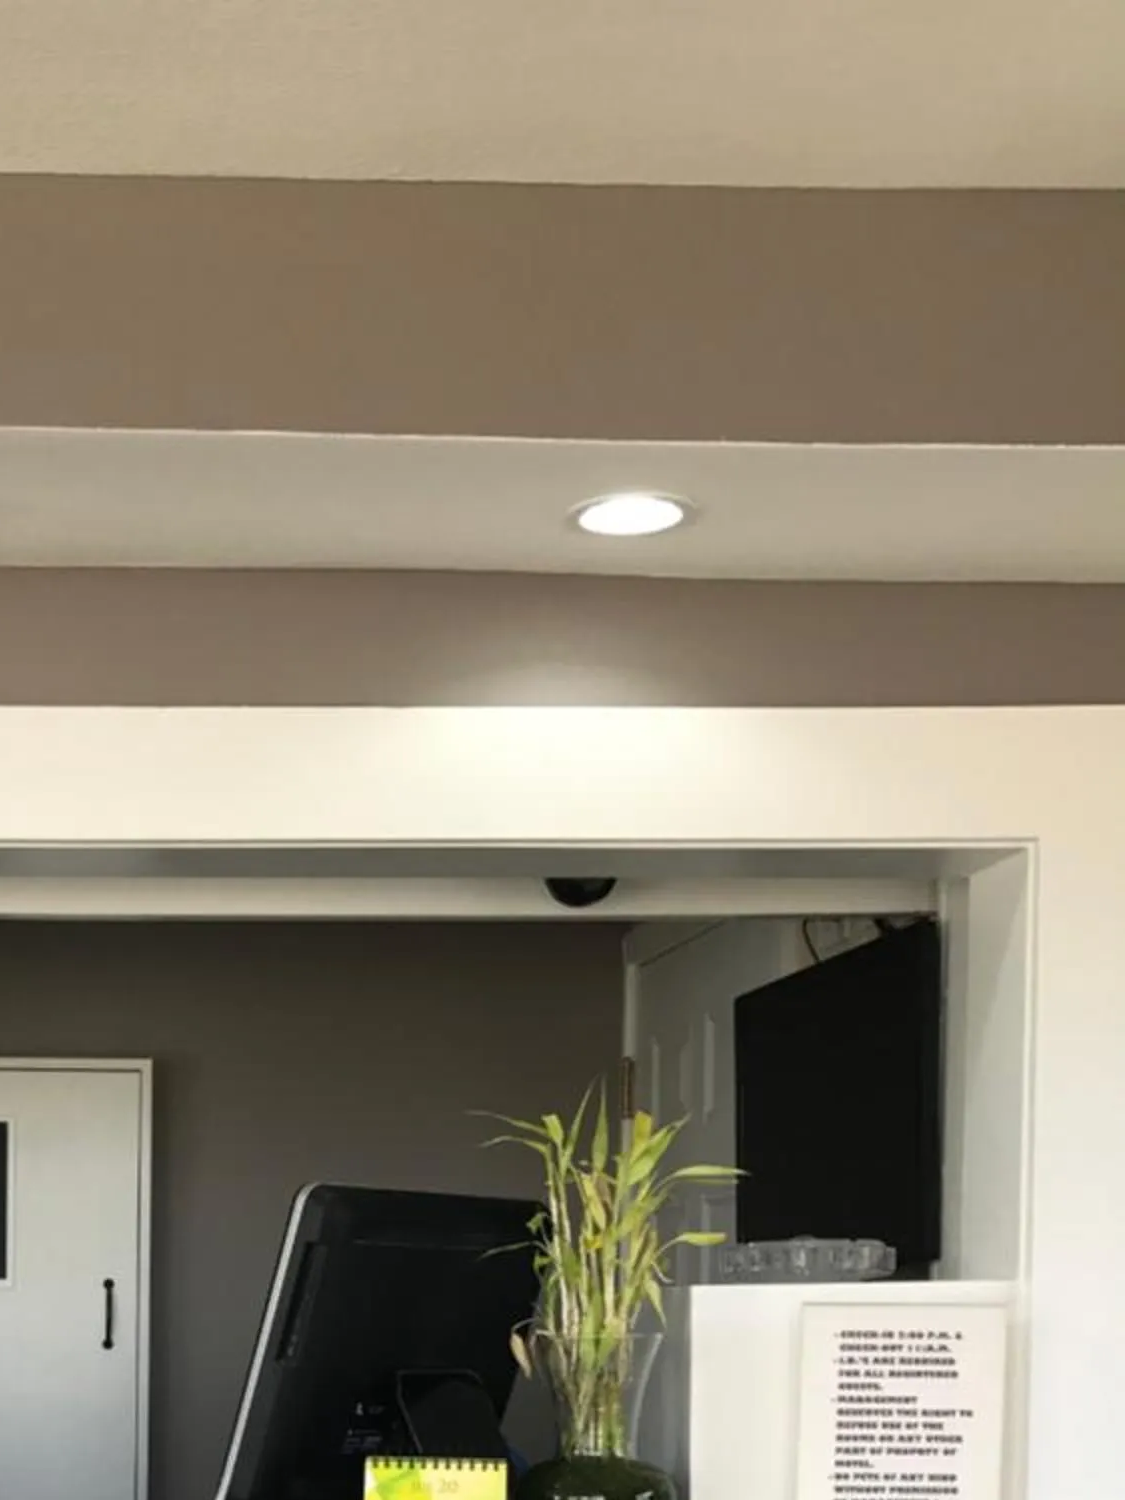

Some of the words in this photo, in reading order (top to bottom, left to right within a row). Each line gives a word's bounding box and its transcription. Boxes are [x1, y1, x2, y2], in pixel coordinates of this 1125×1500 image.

[872, 1356, 895, 1366] ARE
[898, 1356, 956, 1366] REQUIRED
[838, 1369, 861, 1379] FOR
[864, 1369, 885, 1379] ALL
[888, 1369, 958, 1379] REGISTERED
[836, 1407, 893, 1418] RESERVES
[896, 1407, 918, 1418] THE
[921, 1407, 956, 1418] RIGHT
[959, 1407, 973, 1418] TO
[836, 1420, 878, 1431] REFUSE
[881, 1420, 902, 1431] USE
[904, 1420, 919, 1431] OF
[922, 1420, 944, 1431] THE
[835, 1433, 876, 1444] ROOMS
[878, 1433, 894, 1444] OR
[897, 1433, 922, 1444] ANY
[925, 1433, 963, 1444] OTHER
[834, 1446, 866, 1457] PART
[869, 1446, 883, 1457] OF
[942, 1446, 958, 1457] OF
[852, 1472, 880, 1483] PETS
[883, 1472, 897, 1483] OF
[900, 1472, 925, 1483] ANY
[927, 1472, 958, 1483] KIND
[833, 1485, 886, 1496] WITHOUT
